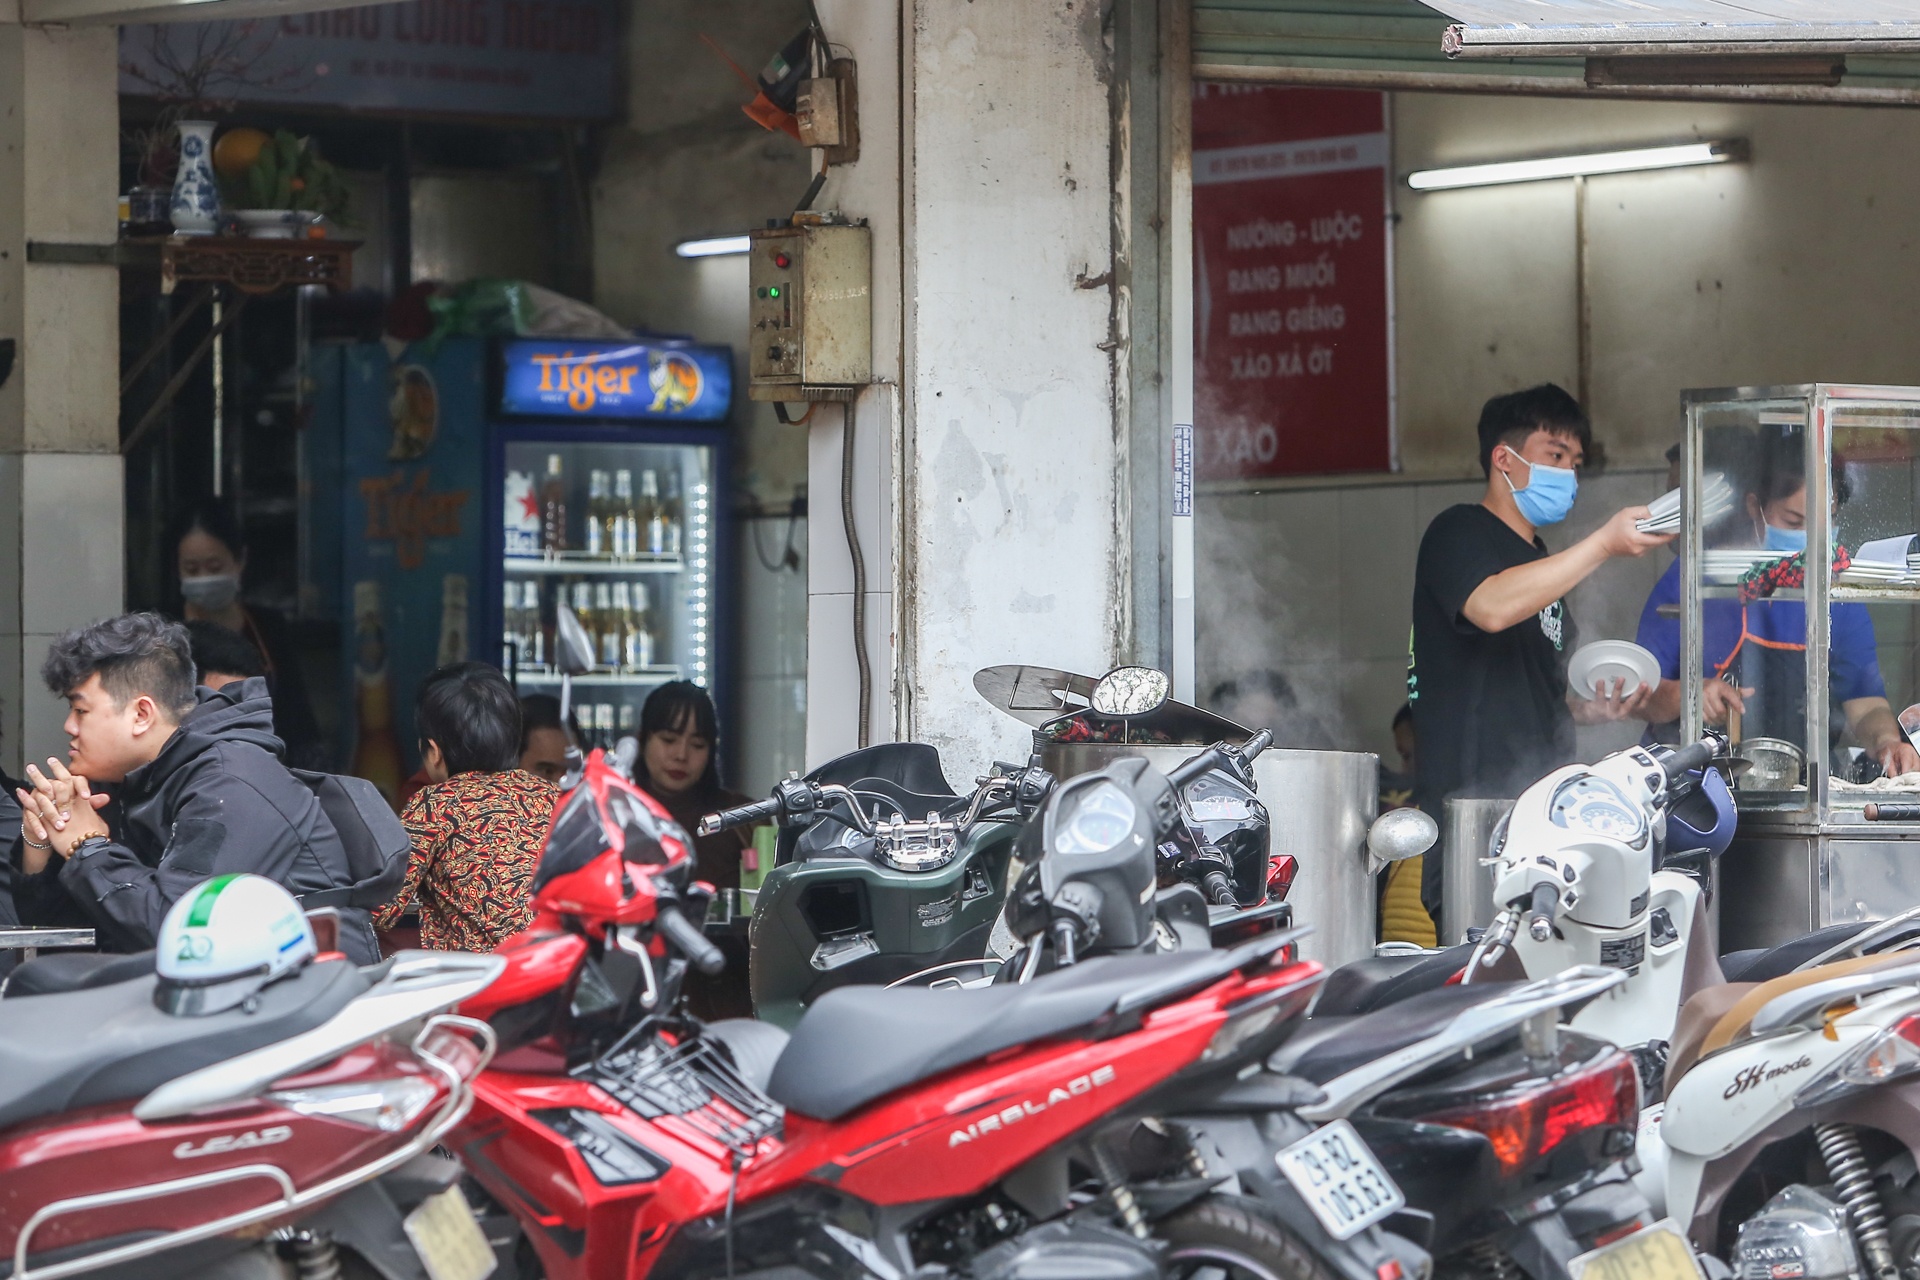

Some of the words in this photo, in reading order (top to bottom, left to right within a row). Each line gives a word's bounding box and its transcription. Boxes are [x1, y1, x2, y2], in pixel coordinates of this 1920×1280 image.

[1310, 210, 1363, 249] LUỘC
[1228, 264, 1282, 294] RANG
[1285, 251, 1336, 289] MUỐI
[1229, 308, 1282, 336] RANG
[531, 351, 639, 412] Tiger
[1723, 1059, 1770, 1100] SH
[1765, 1054, 1812, 1081] mode
[173, 1125, 293, 1158] LEAD
